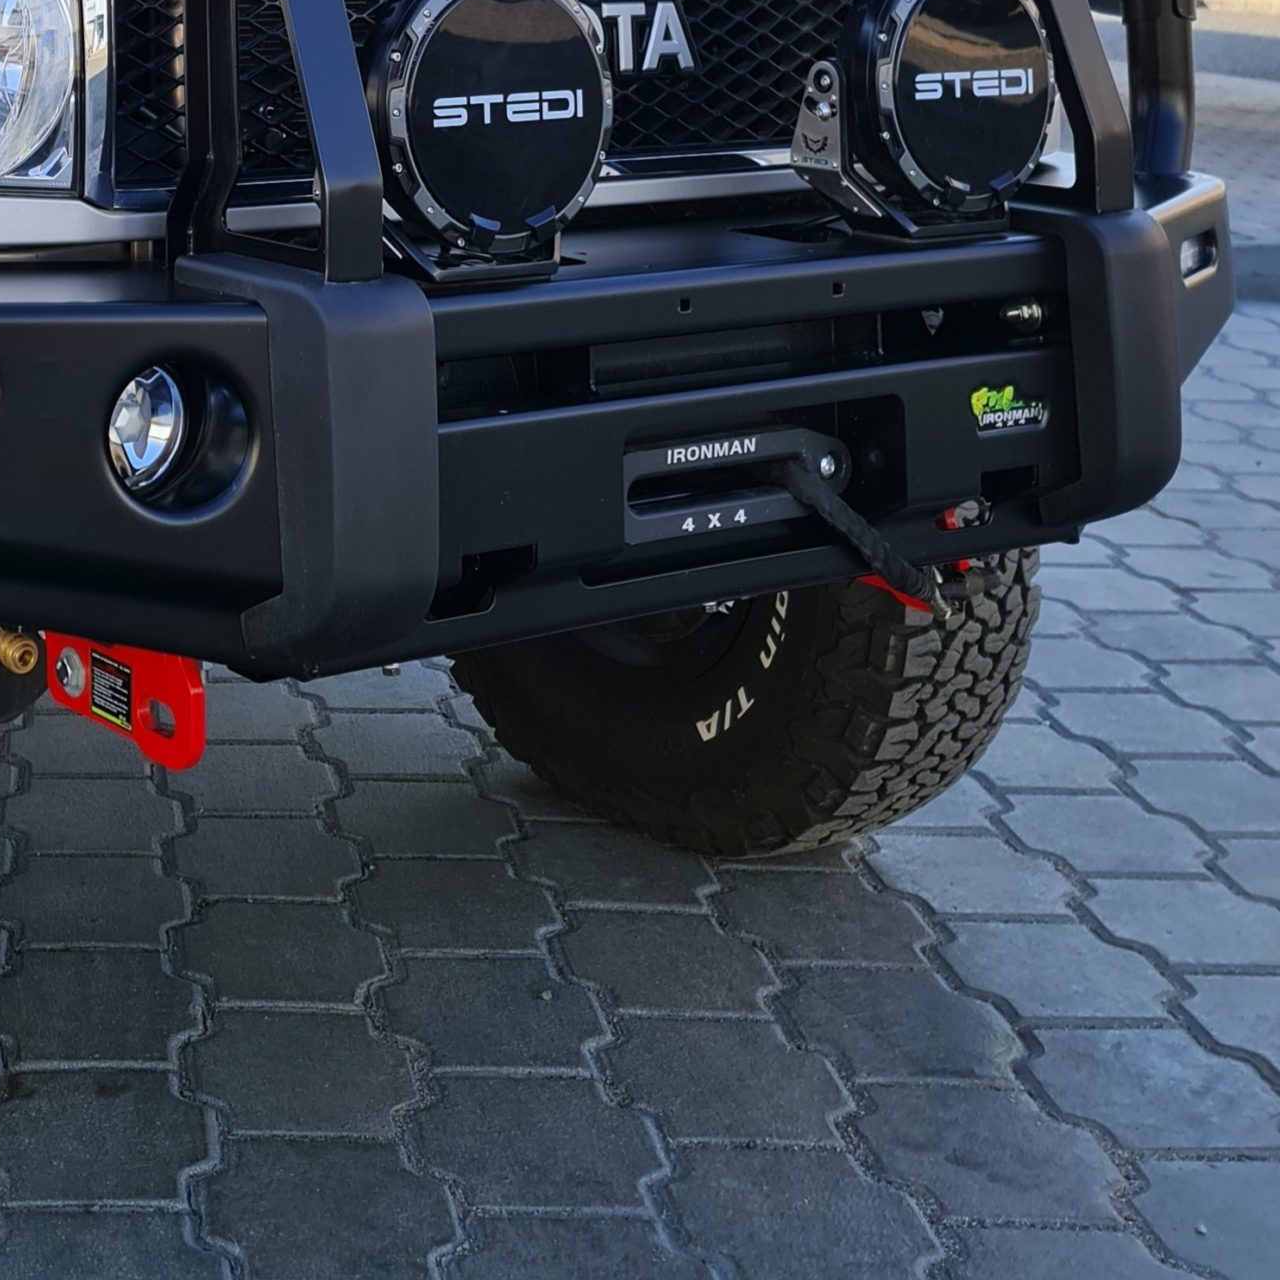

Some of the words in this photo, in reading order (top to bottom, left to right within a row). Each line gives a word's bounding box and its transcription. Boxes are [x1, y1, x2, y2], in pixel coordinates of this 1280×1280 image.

[914, 67, 1034, 101] STEDI
[433, 90, 584, 128] STEDI
[666, 437, 757, 465] IRONMAN
[759, 590, 789, 670] ain
